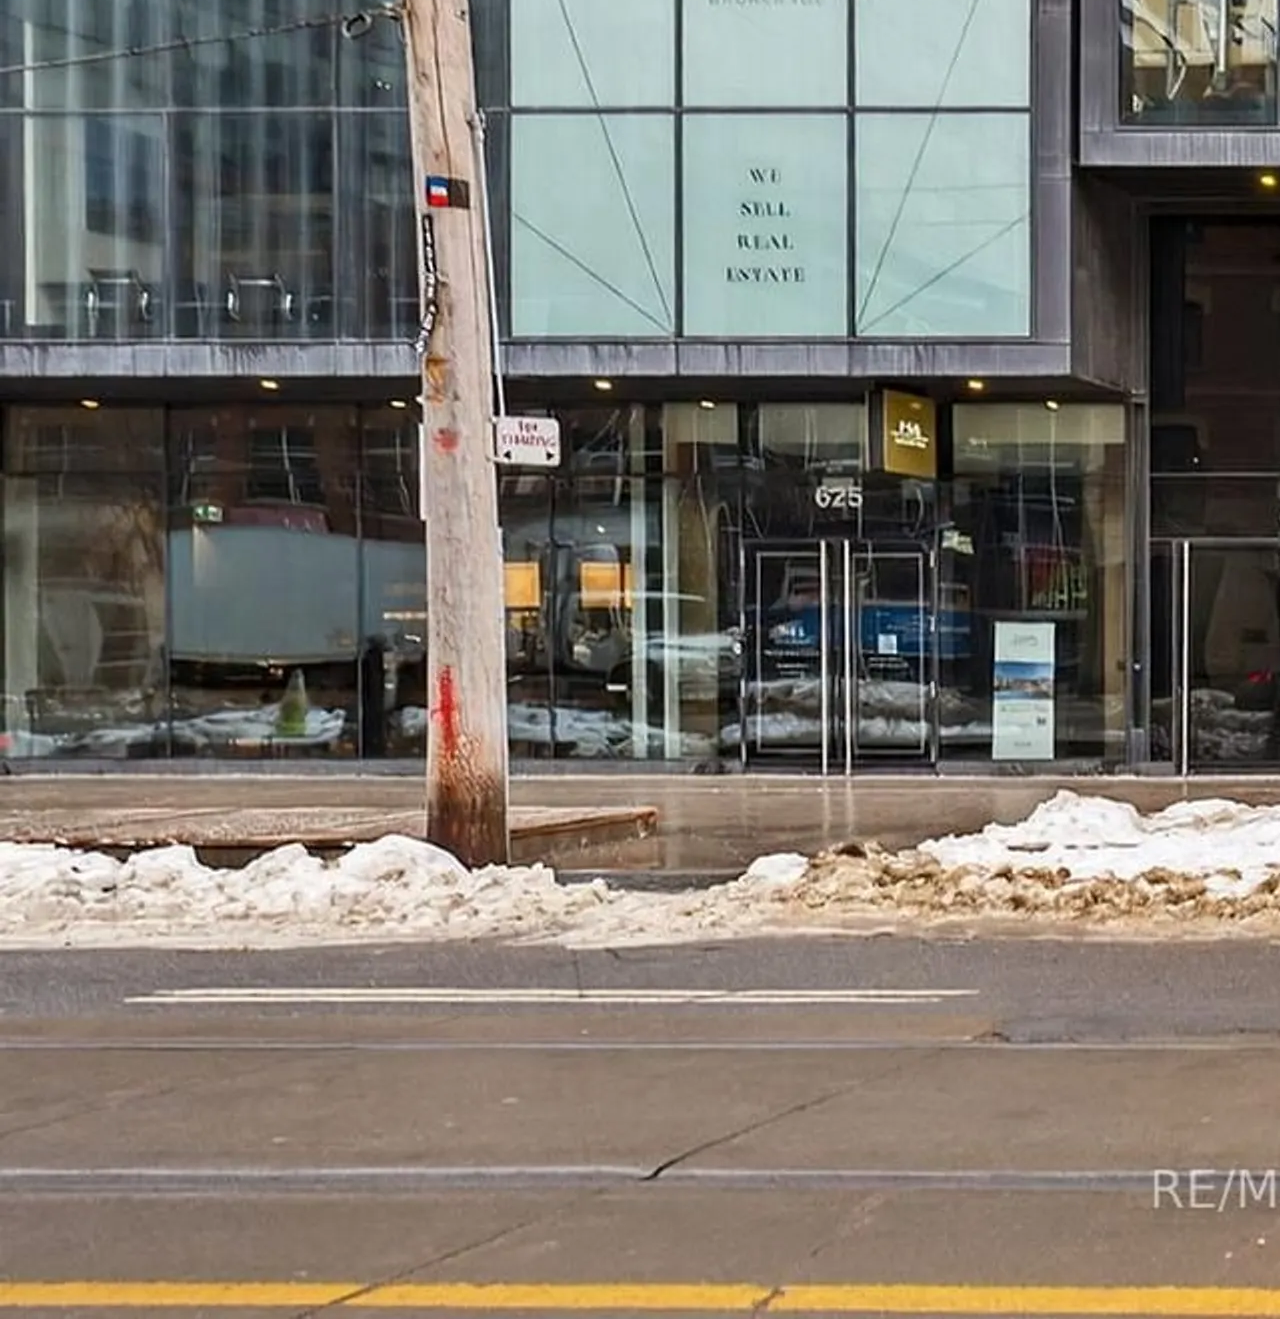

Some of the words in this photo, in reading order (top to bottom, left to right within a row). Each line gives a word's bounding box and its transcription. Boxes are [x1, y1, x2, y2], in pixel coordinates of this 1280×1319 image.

[736, 233, 795, 251] REAL
[725, 266, 806, 283] ESTATE
[814, 484, 863, 509] 625
